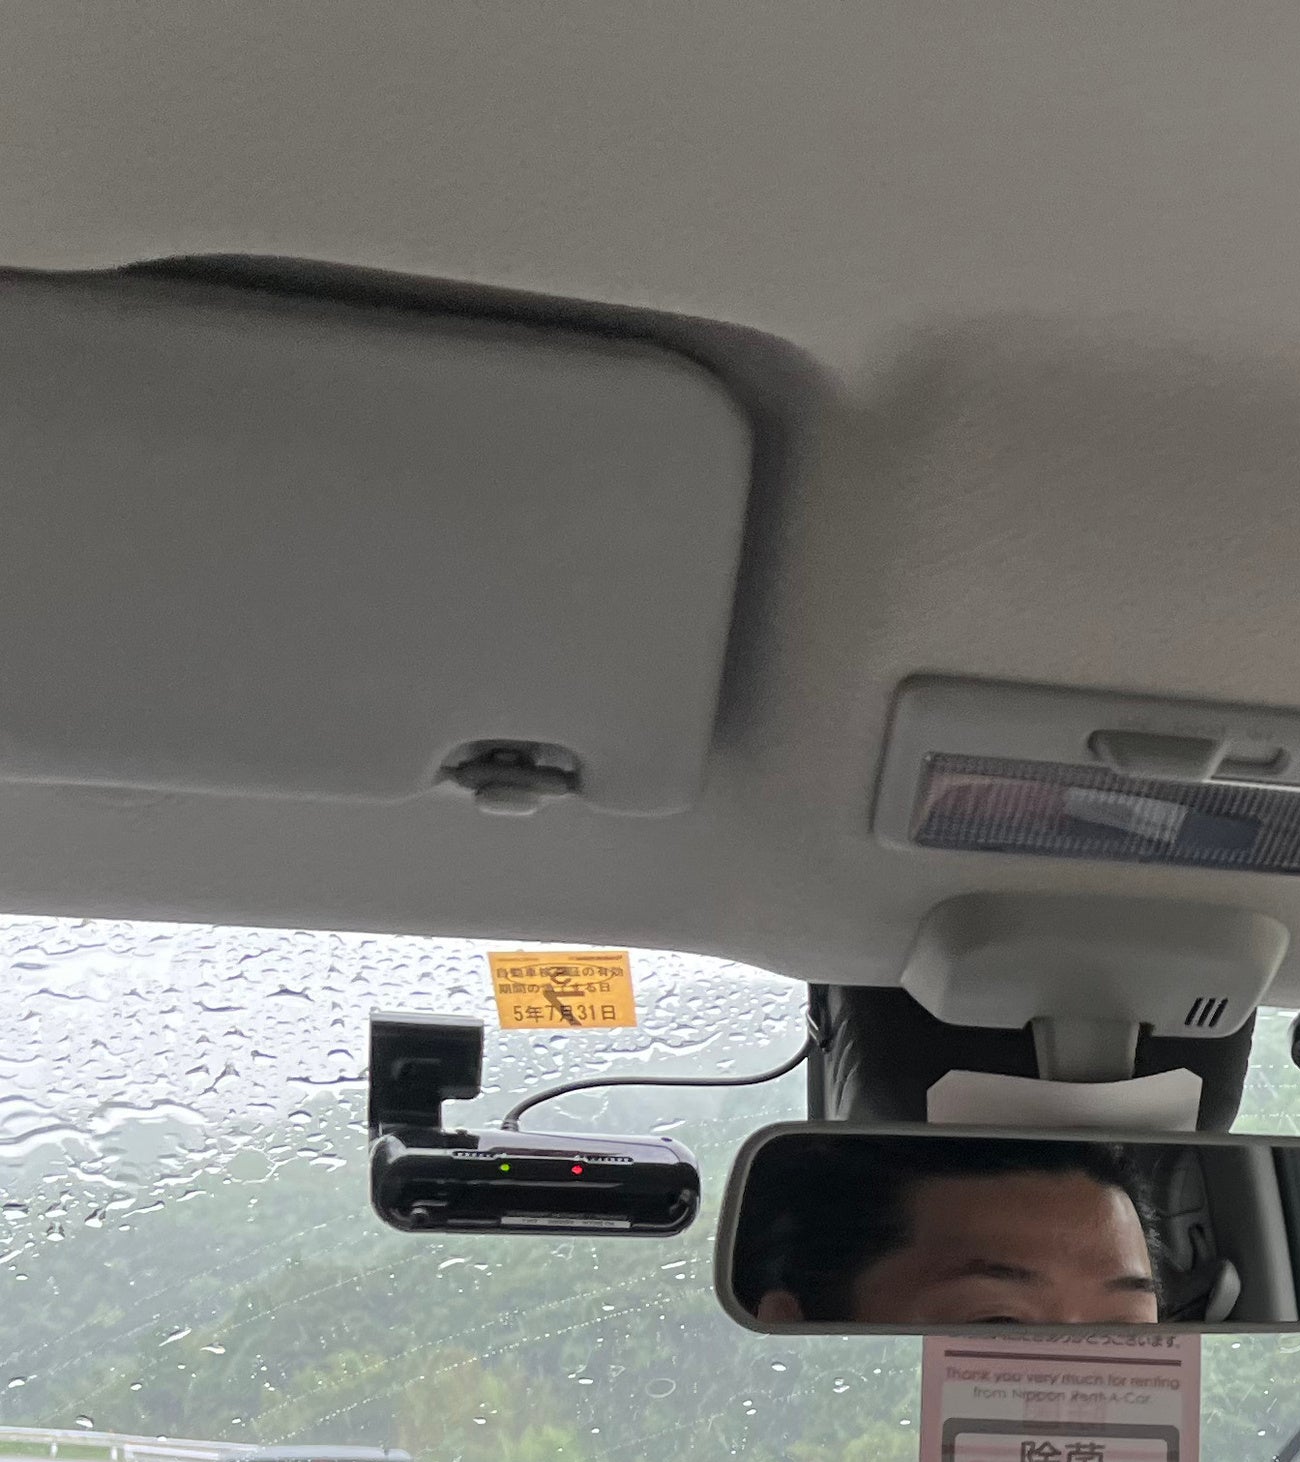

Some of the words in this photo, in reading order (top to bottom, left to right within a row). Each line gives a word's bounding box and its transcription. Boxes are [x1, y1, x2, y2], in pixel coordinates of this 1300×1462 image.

[946, 1366, 991, 1381] Thank
[994, 1370, 1021, 1385] you
[1027, 1371, 1059, 1386] very
[1062, 1371, 1105, 1386] much
[1108, 1374, 1126, 1387] for
[1129, 1376, 1180, 1391] renting
[973, 1386, 1006, 1400] from
[1012, 1388, 1066, 1404] Nippon
